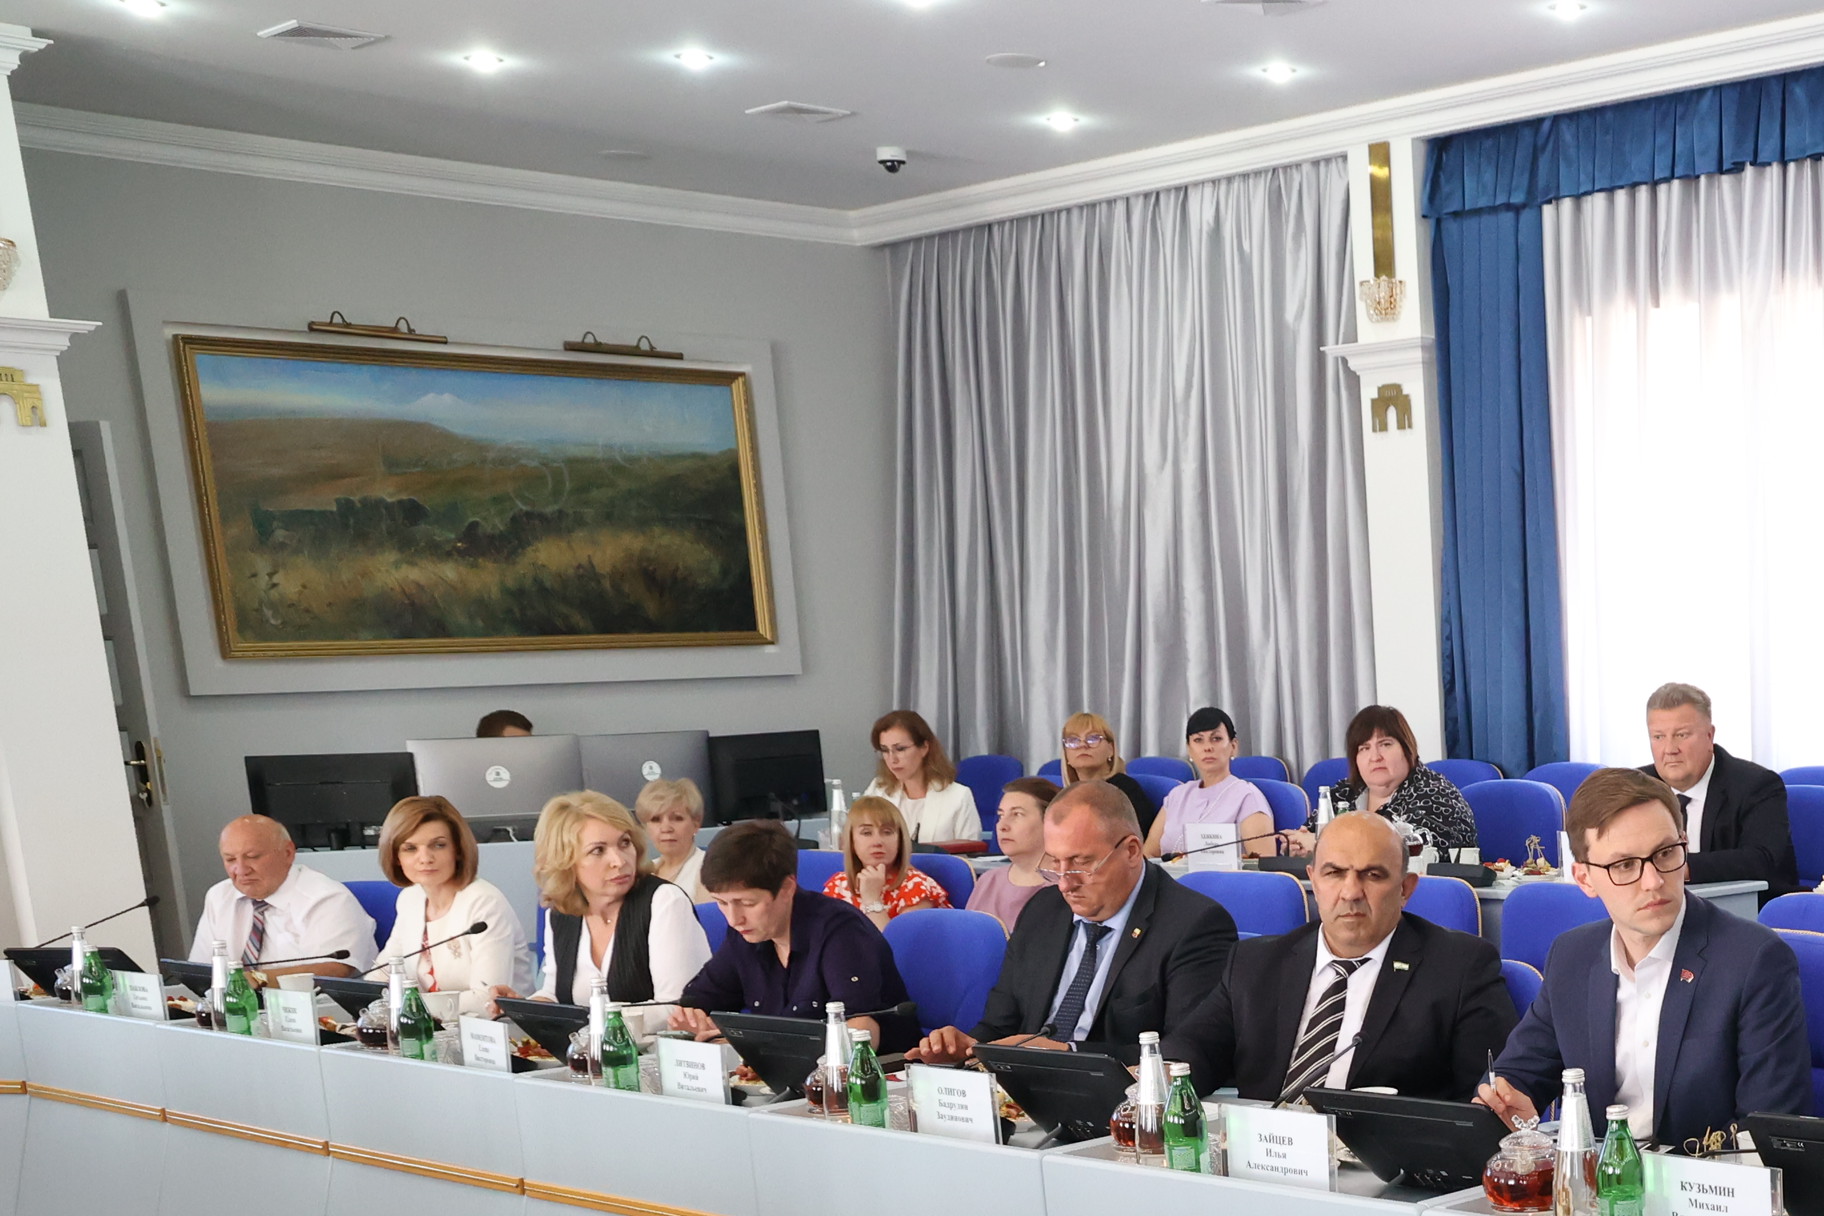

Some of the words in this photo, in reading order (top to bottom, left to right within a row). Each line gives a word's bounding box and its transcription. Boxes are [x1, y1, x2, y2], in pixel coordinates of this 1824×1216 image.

[937, 1086, 967, 1098] ОЛИГОВ
[1257, 1132, 1294, 1147] ЗАЙЦЕВ
[1265, 1147, 1287, 1160] Илья
[1245, 1160, 1309, 1176] Александрович
[1680, 1180, 1736, 1198] КУЗЬМИН
[1688, 1197, 1729, 1213] Михаил
